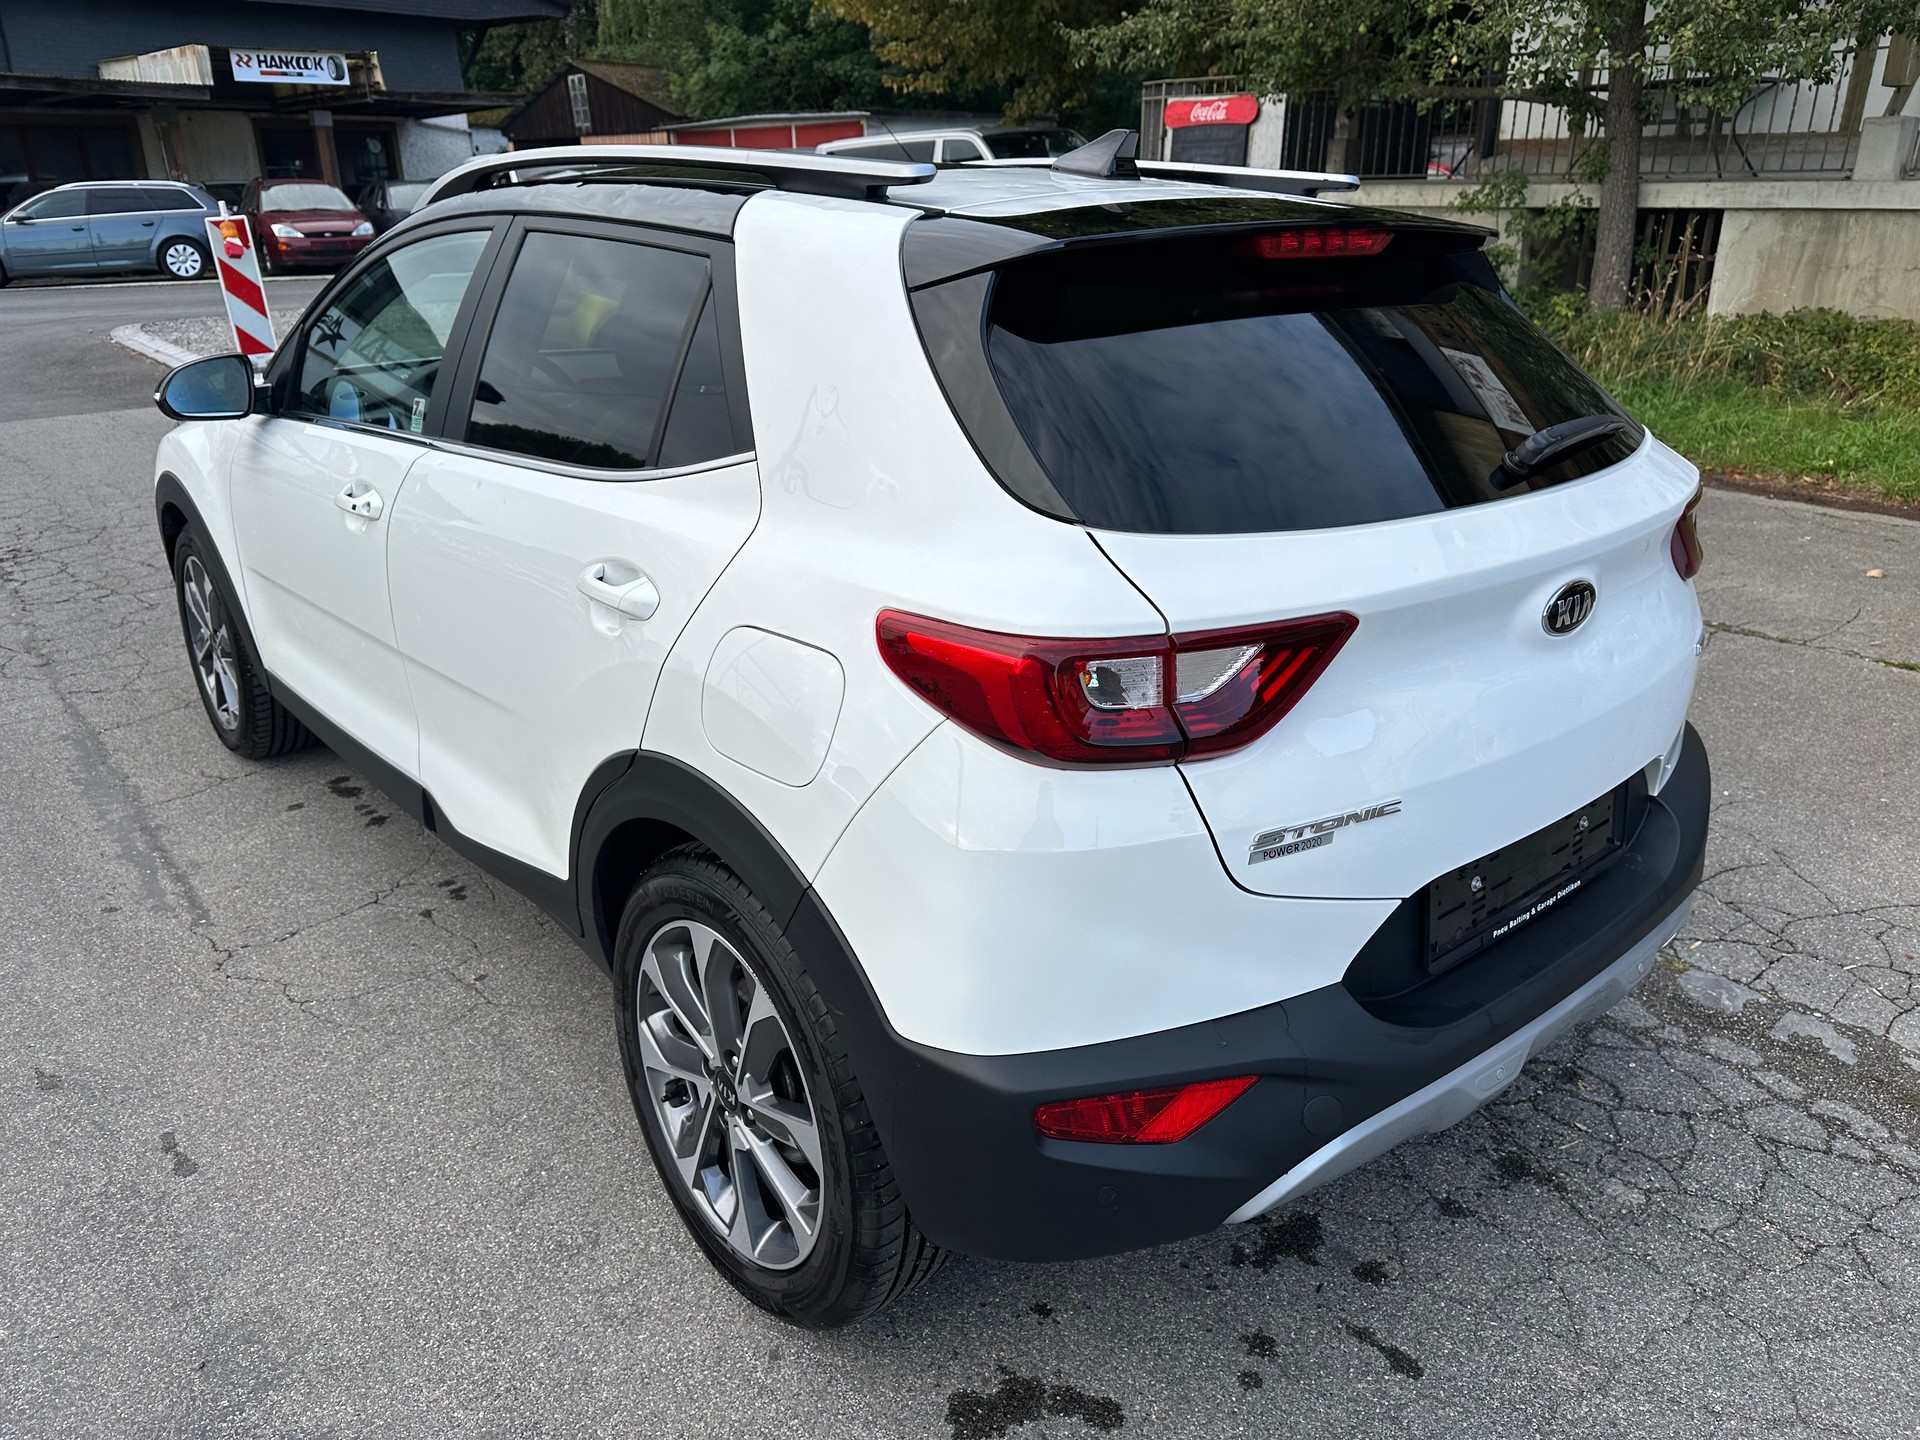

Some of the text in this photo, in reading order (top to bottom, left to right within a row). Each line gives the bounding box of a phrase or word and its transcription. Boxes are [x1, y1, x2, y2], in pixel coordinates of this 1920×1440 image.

[256, 54, 324, 71] HANKOOK
[1556, 590, 1592, 628] KIA
[1248, 799, 1403, 852] STONIC
[1493, 880, 1581, 938] Pneu Balting & Garage Dietlikon
